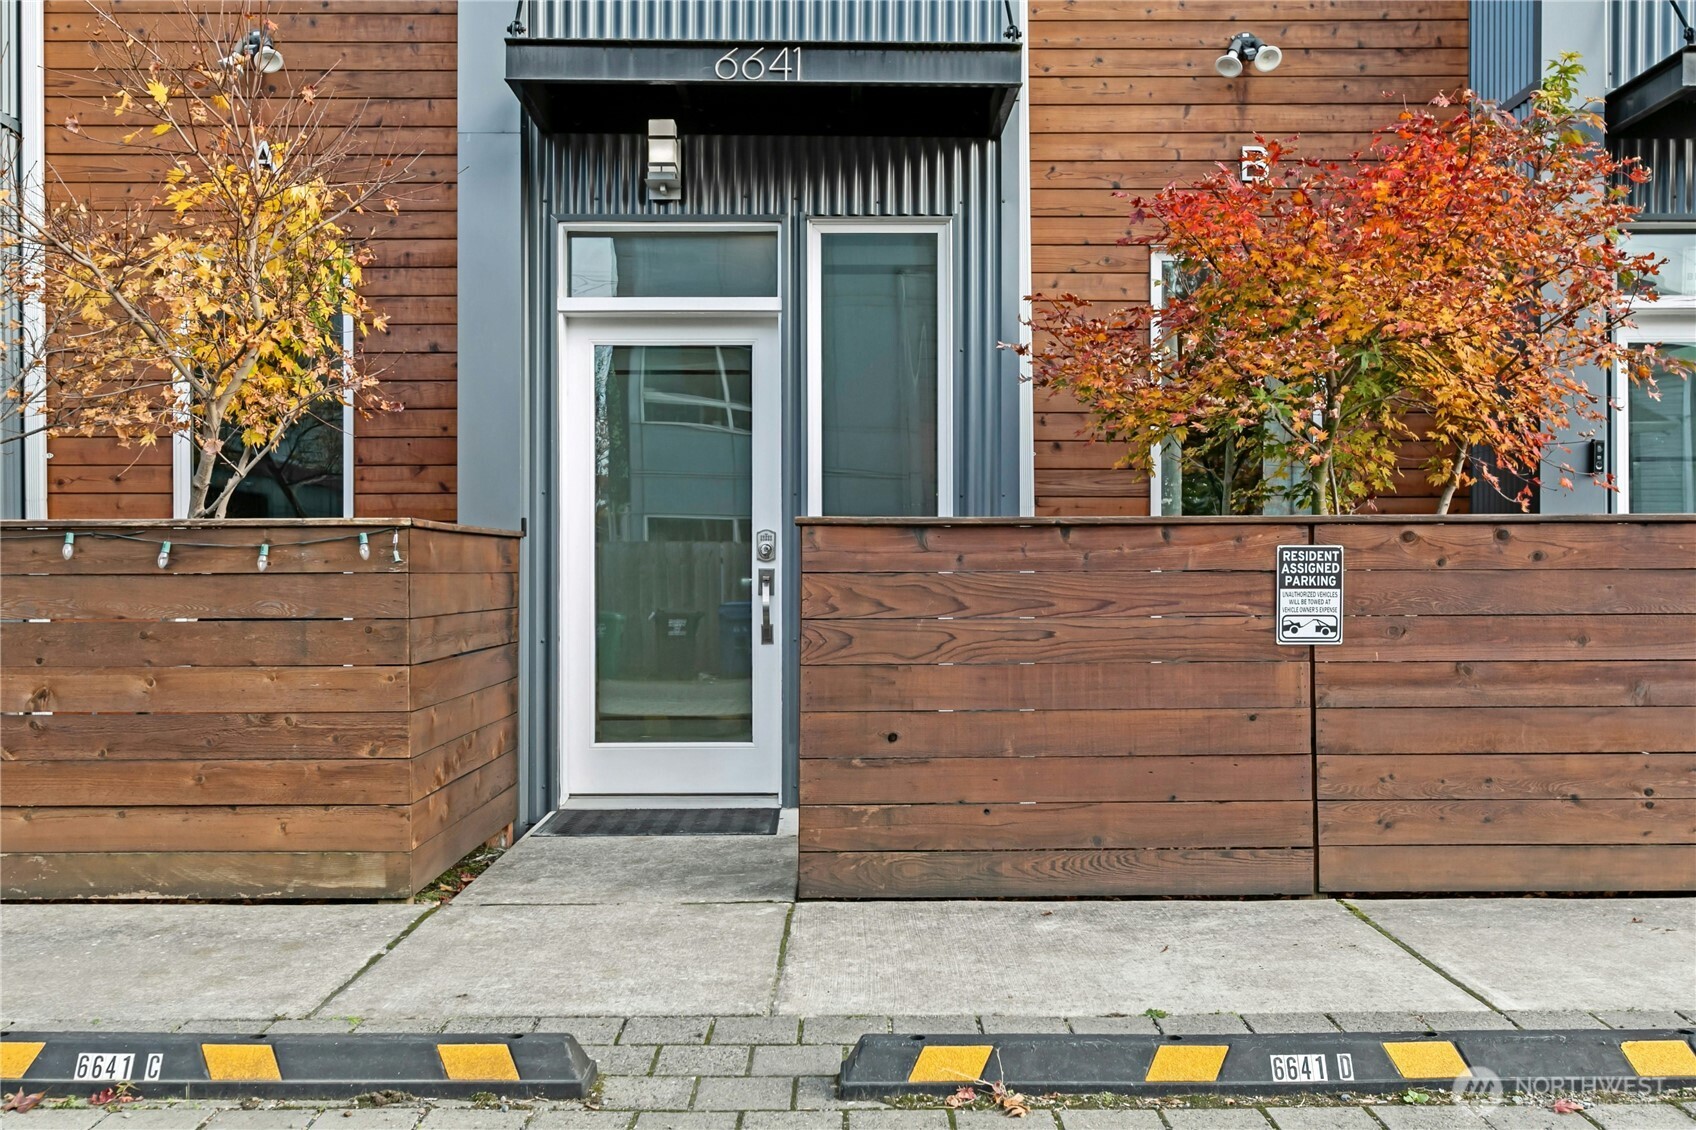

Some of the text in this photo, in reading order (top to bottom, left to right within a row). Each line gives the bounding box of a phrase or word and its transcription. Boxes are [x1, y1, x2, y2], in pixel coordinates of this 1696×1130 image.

[715, 47, 801, 80] 6641
[250, 140, 278, 175] A
[1241, 145, 1270, 181] B
[1283, 550, 1340, 561] RESIDENT
[1281, 563, 1340, 574] ASSIGNED
[1285, 575, 1337, 587] PARKING
[77, 1055, 160, 1079] 6641 C
[1273, 1055, 1352, 1080] 6641 D
